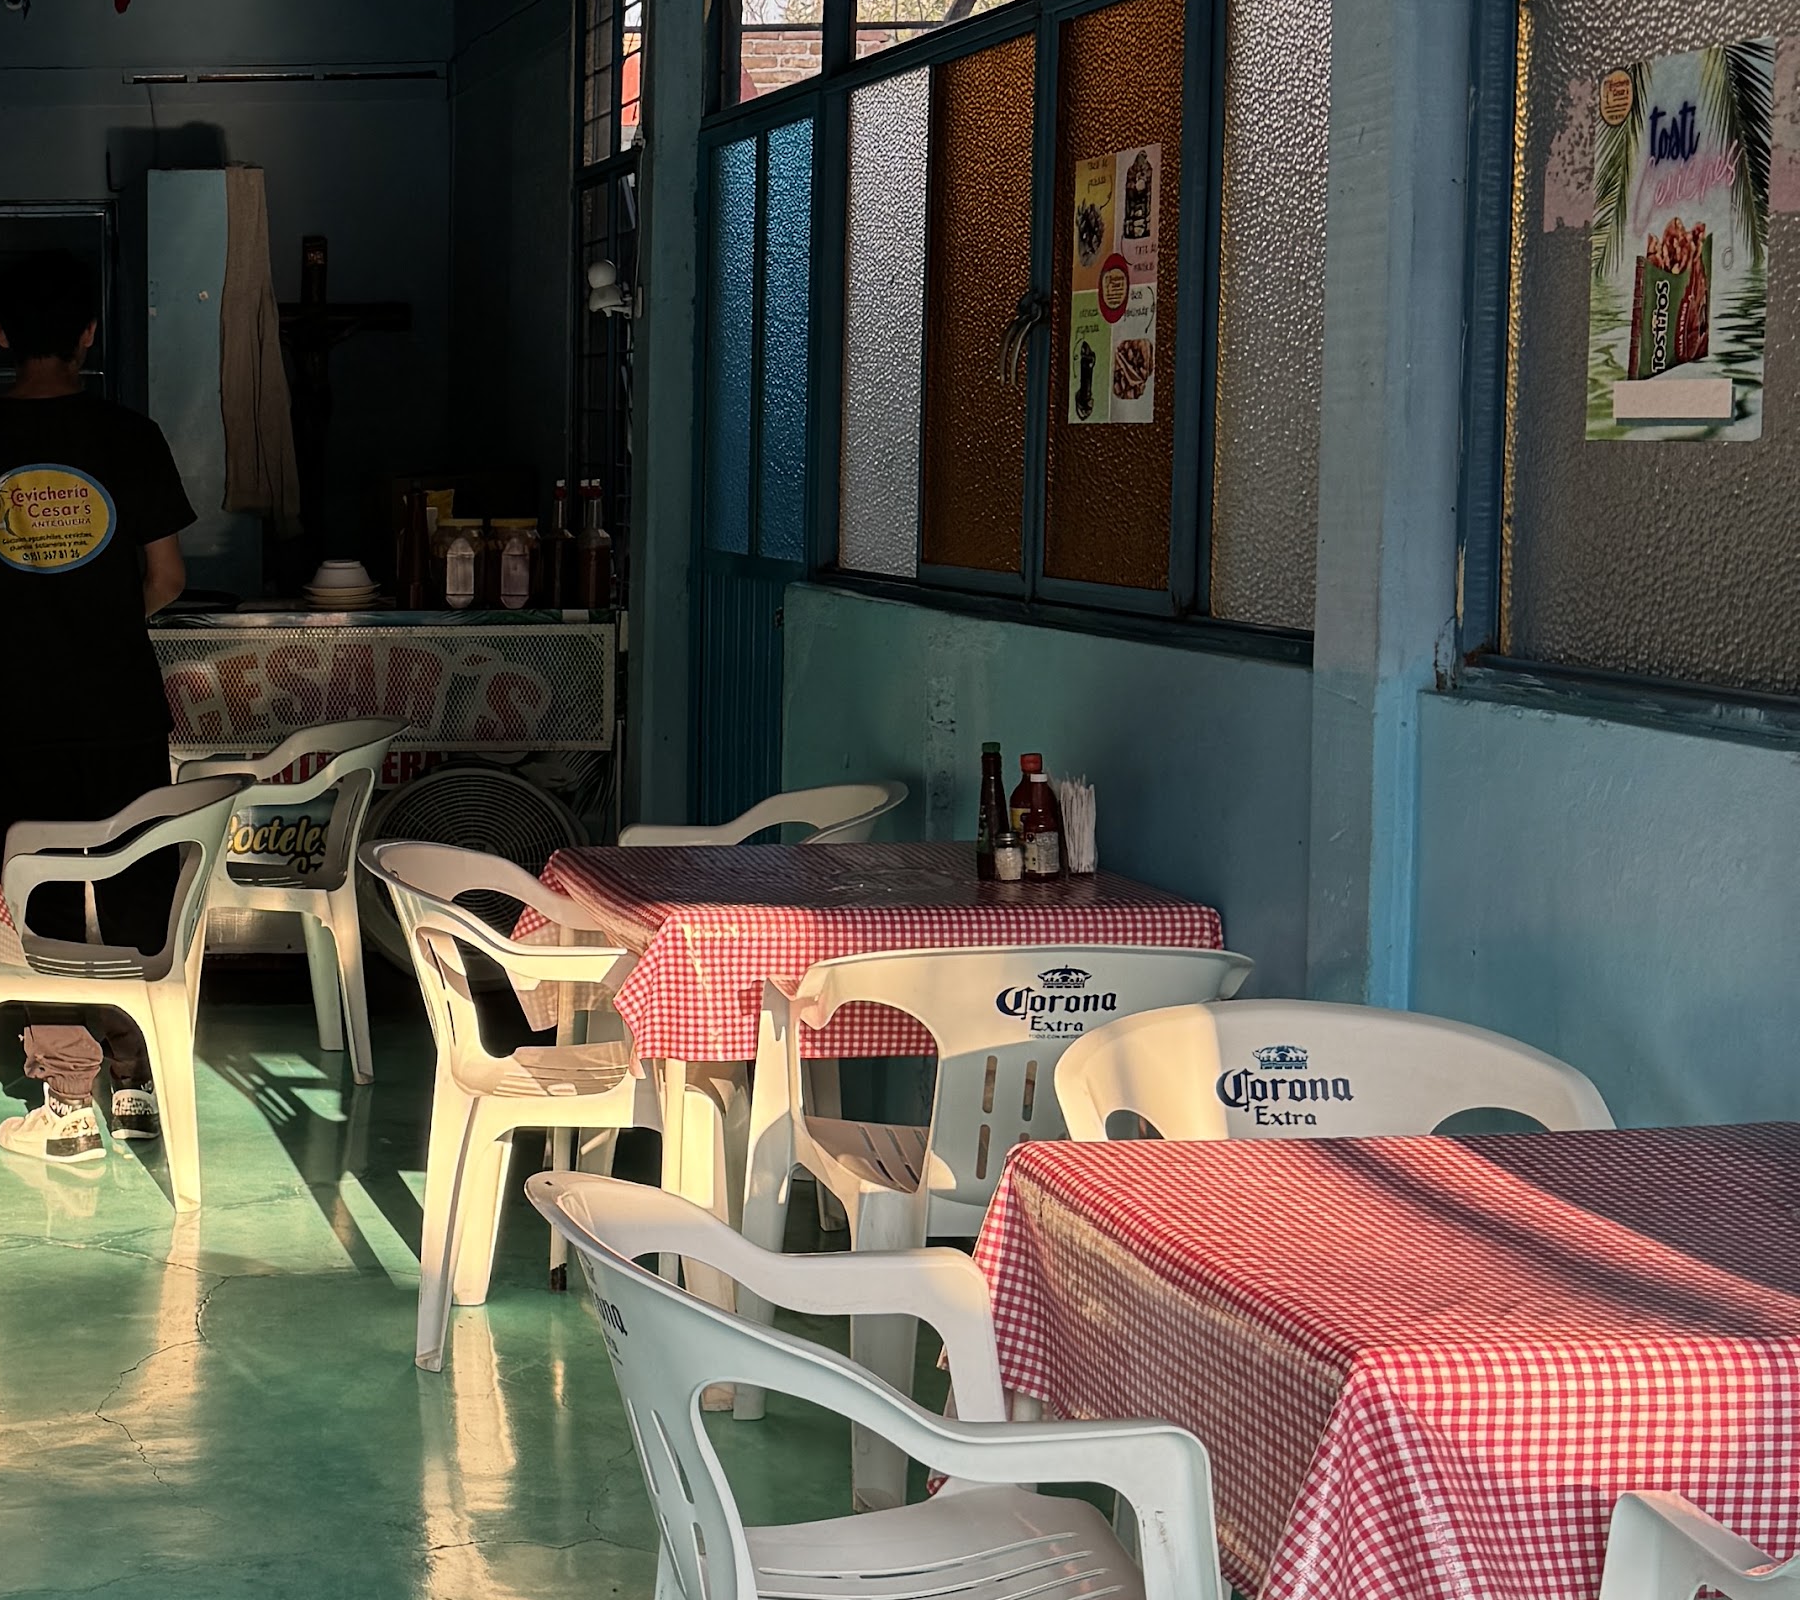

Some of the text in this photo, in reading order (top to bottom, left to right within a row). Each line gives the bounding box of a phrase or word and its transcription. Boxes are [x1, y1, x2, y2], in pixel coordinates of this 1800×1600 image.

[1649, 100, 1701, 167] tosti
[1650, 279, 1671, 374] TOSTITOS
[11, 484, 89, 507] Cevichería
[28, 500, 91, 518] Cesar's
[995, 986, 1117, 1020] Corona
[1030, 1015, 1084, 1032] Extra
[1215, 1067, 1355, 1112] Corona
[1254, 1105, 1318, 1126] Extra
